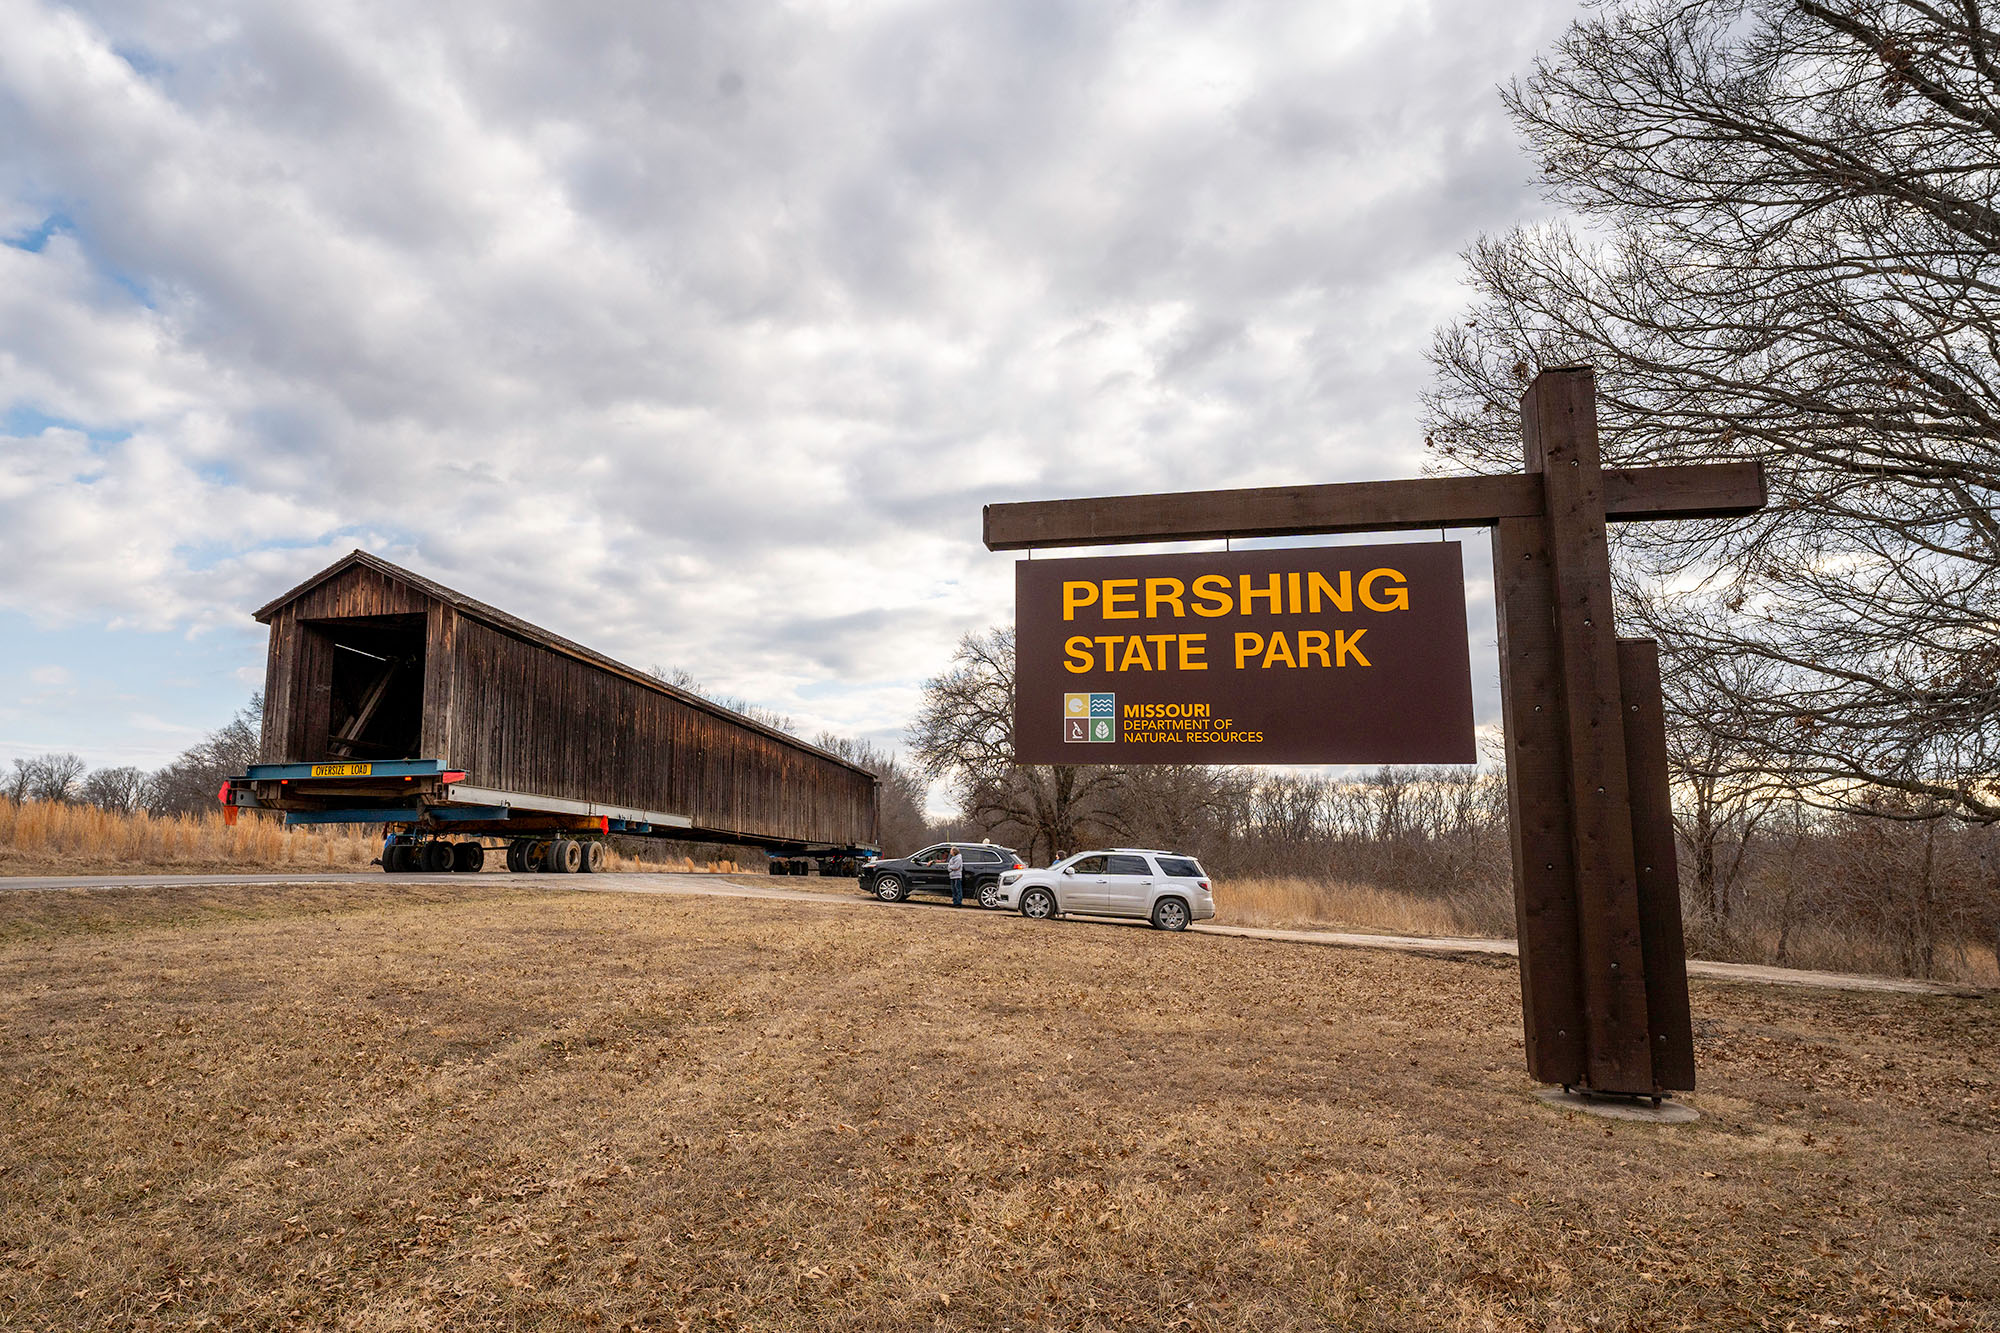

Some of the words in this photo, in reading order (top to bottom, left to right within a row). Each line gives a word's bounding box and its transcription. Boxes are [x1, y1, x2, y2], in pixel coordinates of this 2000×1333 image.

[1062, 567, 1410, 621] PERSHING
[1063, 633, 1209, 674] STATE
[1234, 628, 1372, 670] PARK
[1123, 703, 1211, 719] MISSOURI
[1123, 719, 1211, 731] DEPARTMENT
[1213, 718, 1233, 731] OF
[1123, 731, 1184, 743] NATURAL
[1186, 731, 1264, 743] RESOURCES
[315, 765, 345, 776] OVERSIZE
[351, 764, 368, 775] LOAD
